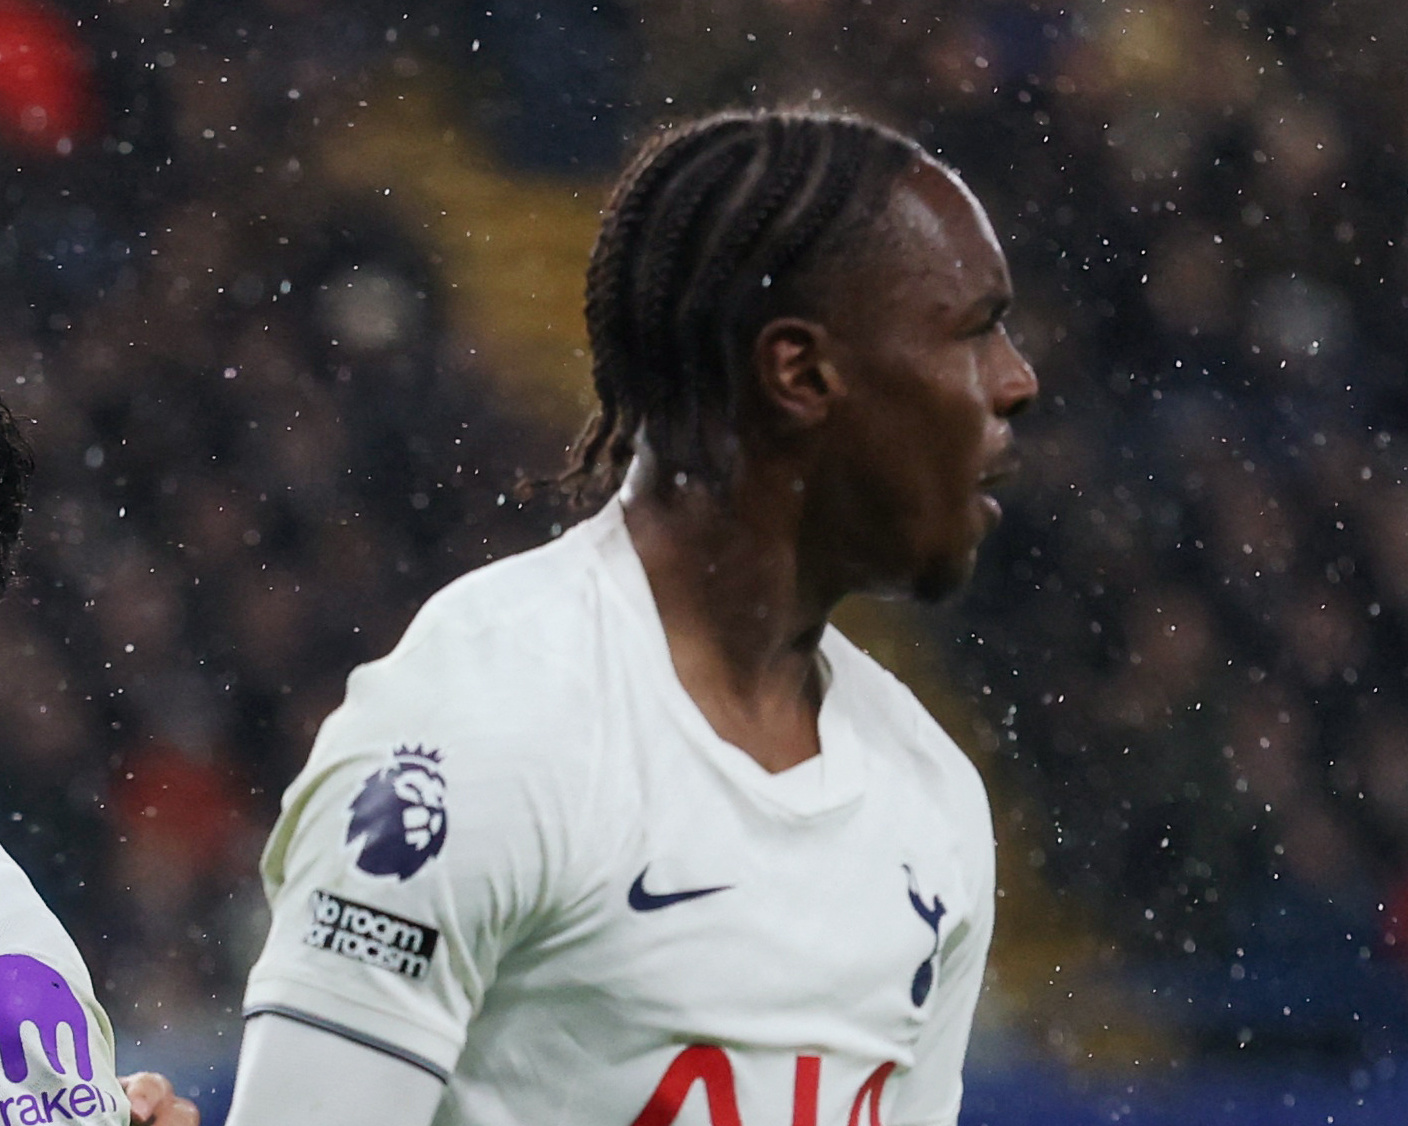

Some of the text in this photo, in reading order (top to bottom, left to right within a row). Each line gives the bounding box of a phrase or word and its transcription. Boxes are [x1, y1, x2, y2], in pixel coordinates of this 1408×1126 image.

[303, 921, 429, 979] or racism
[340, 904, 424, 953] room
